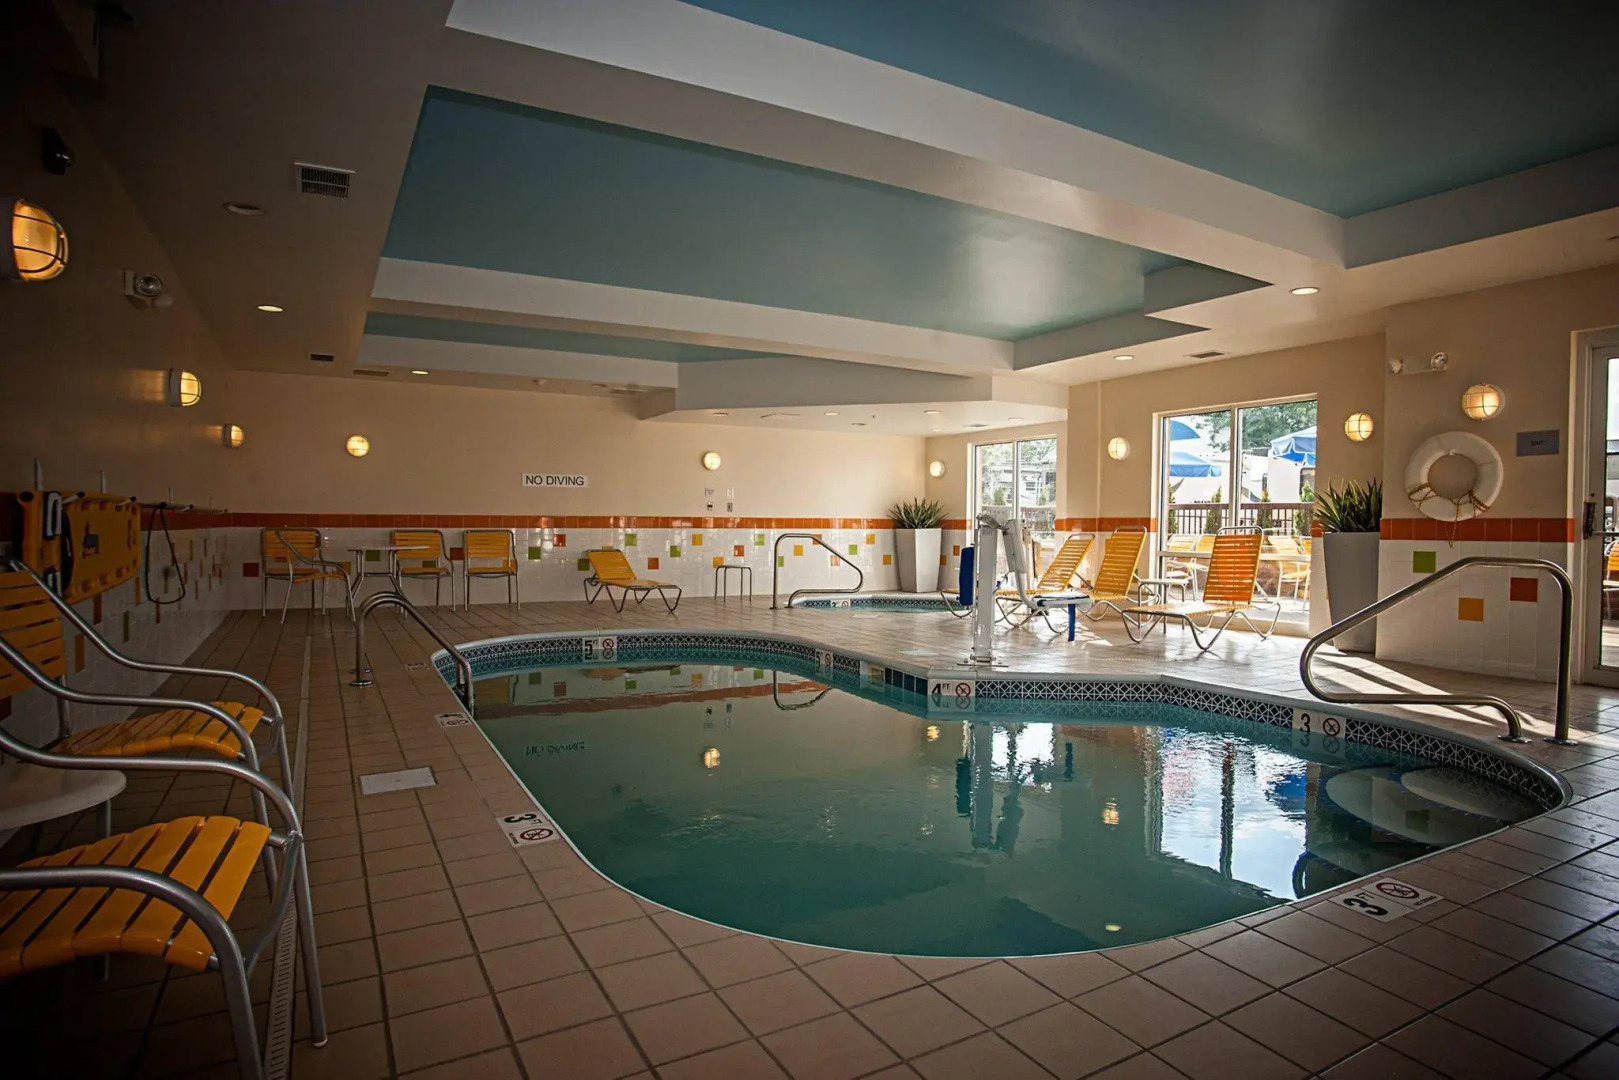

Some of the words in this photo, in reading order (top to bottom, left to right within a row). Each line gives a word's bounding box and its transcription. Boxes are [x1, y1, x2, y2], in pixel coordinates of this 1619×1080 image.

[525, 475, 543, 485] NO
[546, 475, 584, 486] DIVING
[931, 683, 942, 694] 4
[1300, 713, 1311, 732] 3
[504, 813, 537, 823] 3
[1355, 892, 1375, 901] FT
[1343, 898, 1388, 915] 3
